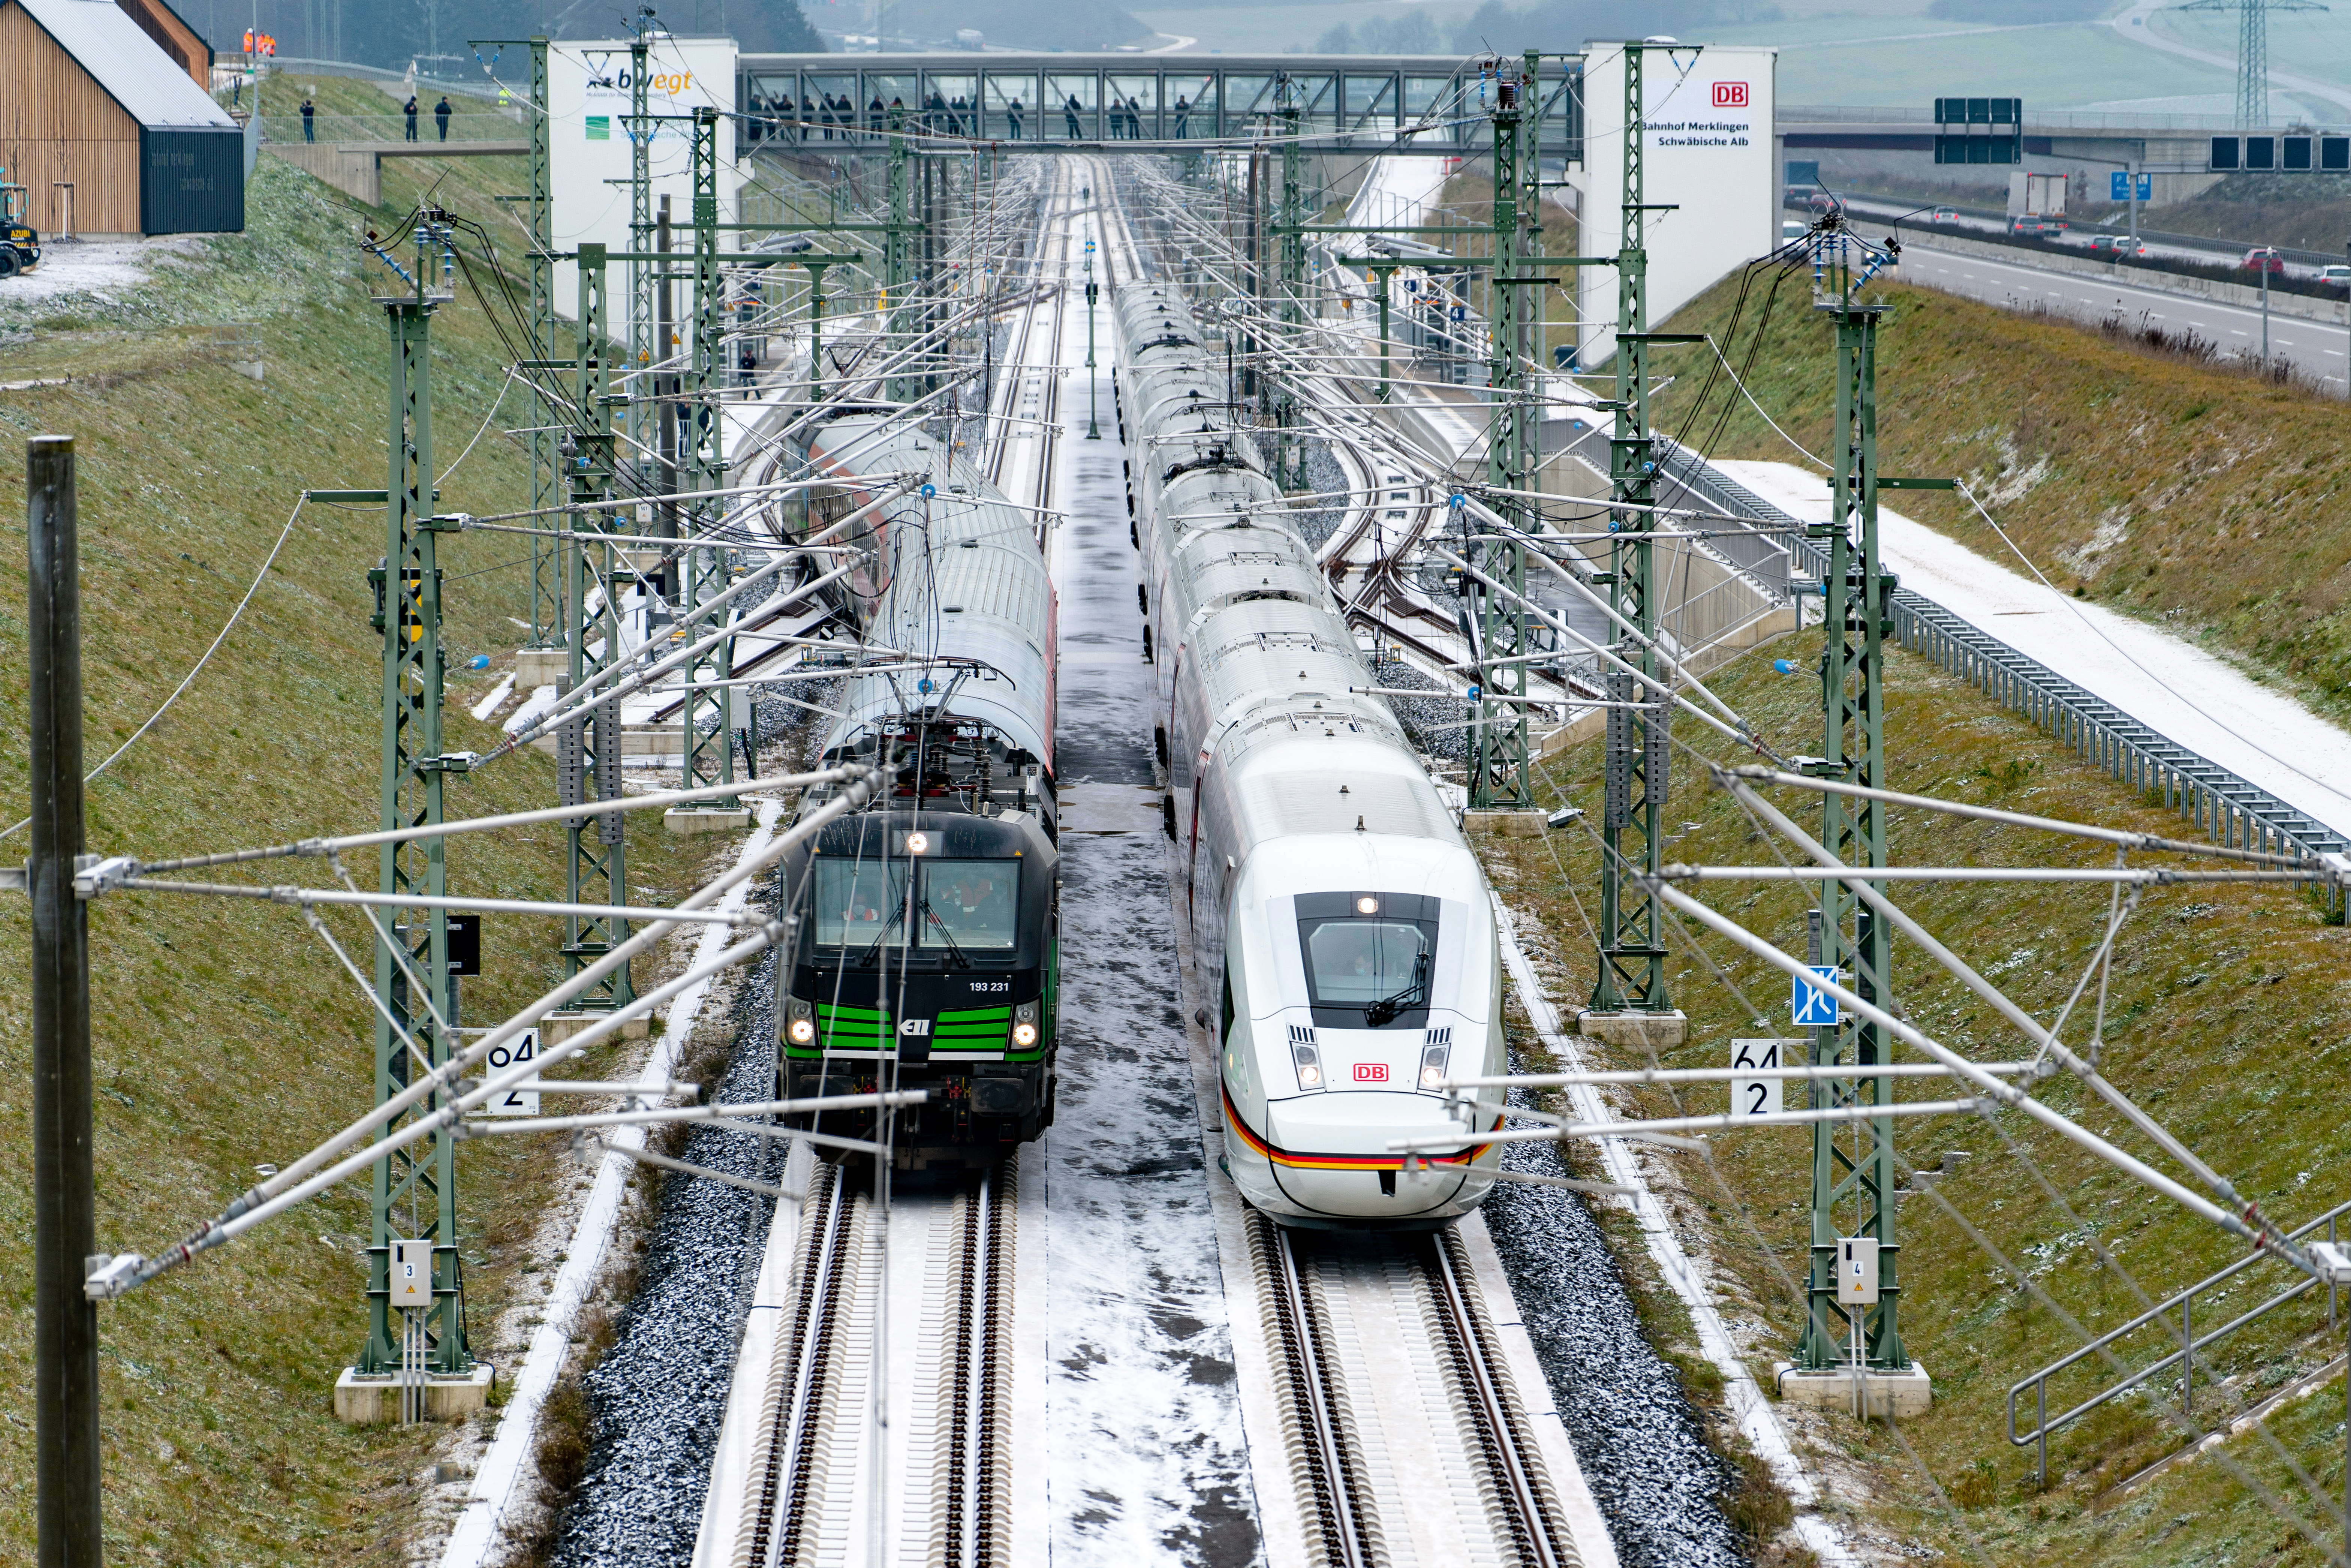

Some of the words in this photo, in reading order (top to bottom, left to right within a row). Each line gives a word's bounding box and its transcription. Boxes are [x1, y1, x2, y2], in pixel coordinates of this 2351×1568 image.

[1717, 86, 1745, 103] DB
[1689, 122, 1749, 133] Merklingen
[1659, 136, 1727, 145] Schwäbische
[1731, 136, 1749, 145] Alb
[11, 229, 30, 237] AZUBI
[1406, 281, 1412, 290] 4
[1452, 308, 1459, 319] 4
[969, 982, 988, 991] 193
[990, 982, 1009, 991] 231
[1358, 1066, 1385, 1078] DB
[1747, 1083, 1767, 1115] 2
[406, 1265, 412, 1276] 3
[1854, 1263, 1861, 1274] 4
